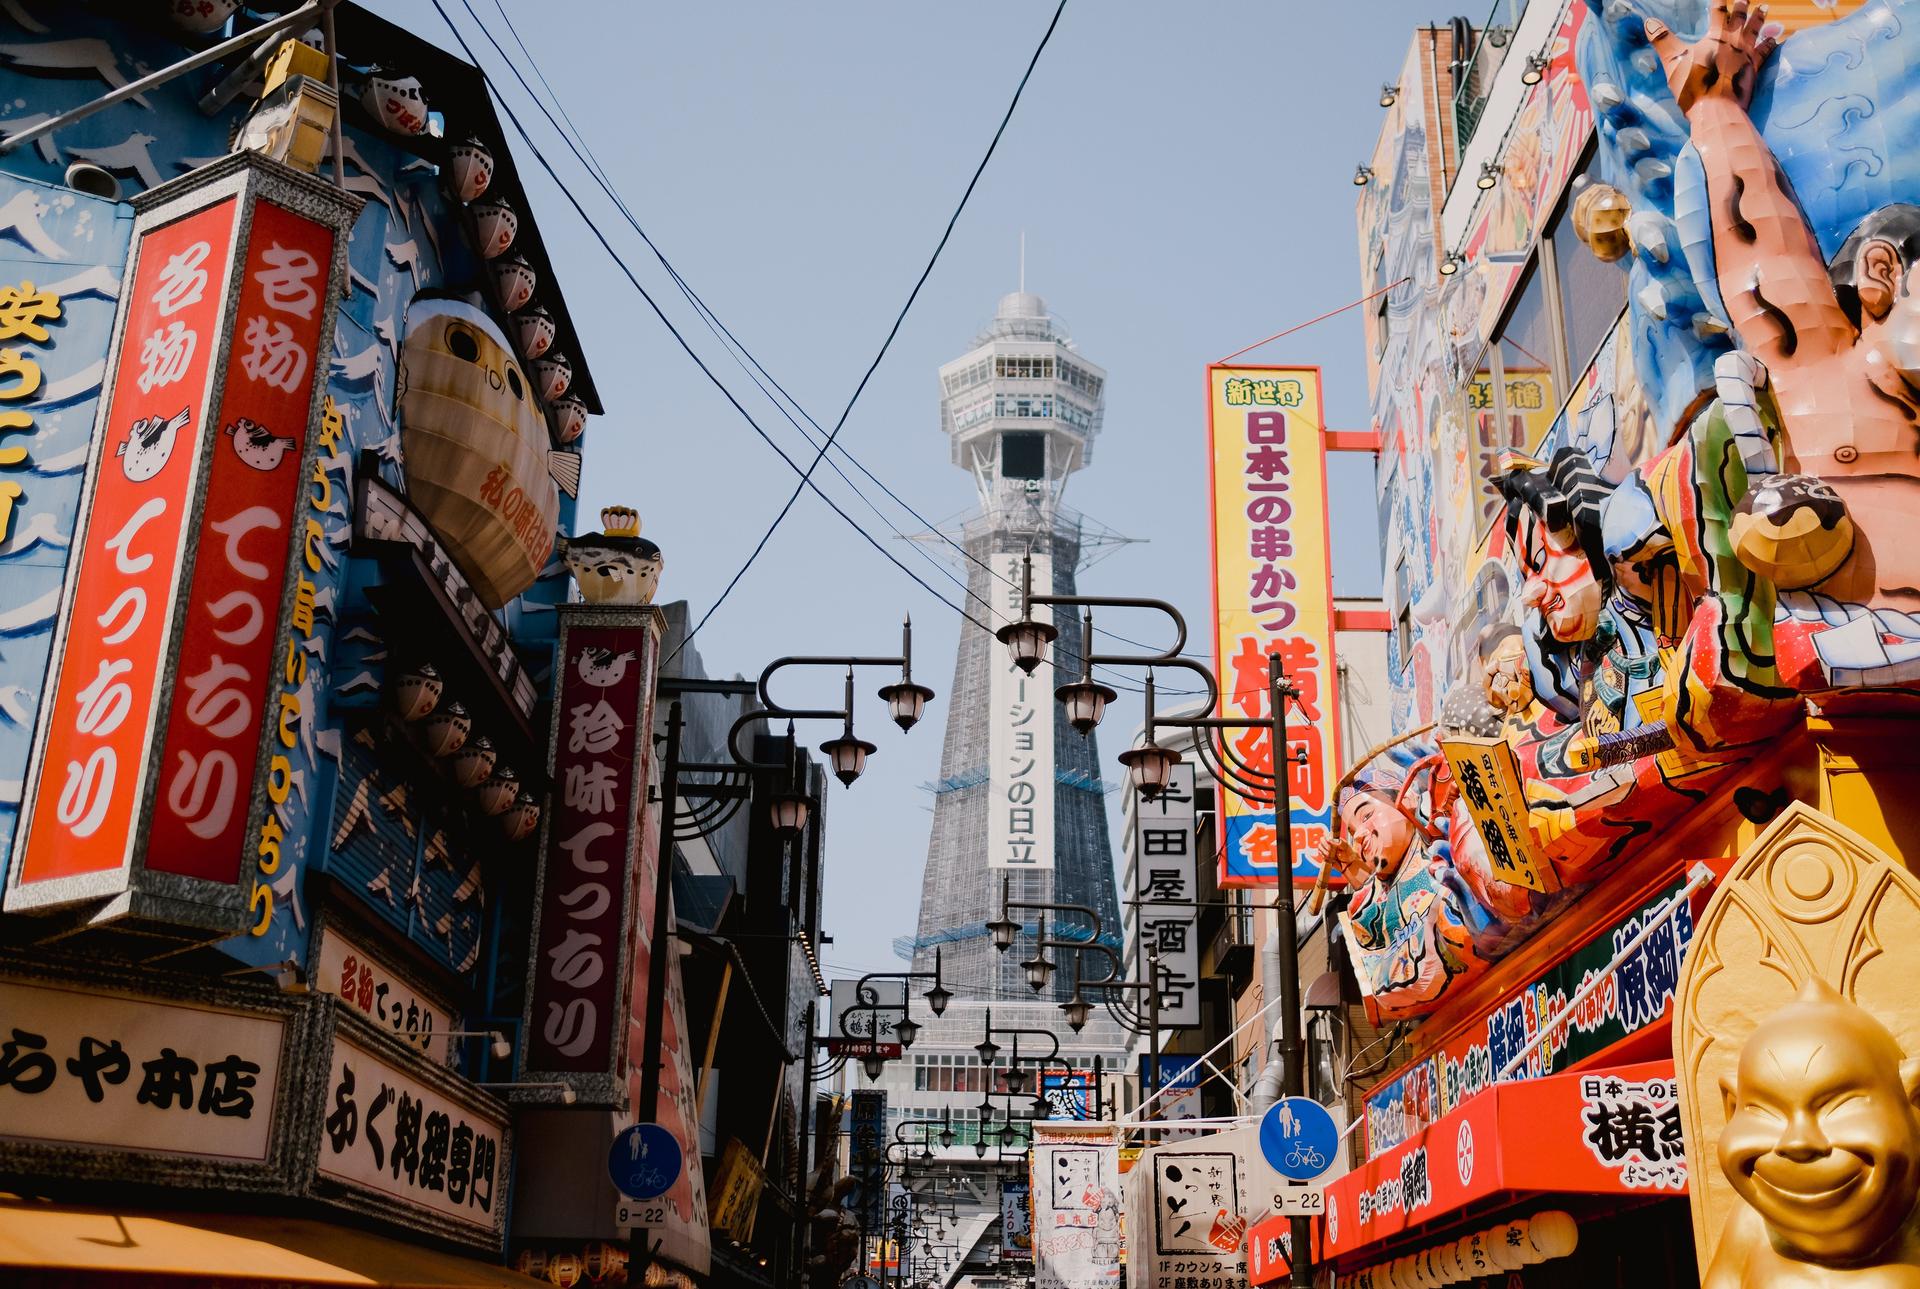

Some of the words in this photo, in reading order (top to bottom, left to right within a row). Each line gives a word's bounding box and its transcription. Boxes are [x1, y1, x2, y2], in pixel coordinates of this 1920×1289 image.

[137, 241, 212, 395] 名物
[242, 242, 320, 394] 名物
[1225, 379, 1303, 406] 新世界
[1245, 411, 1297, 632] 日本一の串かつ
[55, 497, 167, 840] てっちり
[168, 505, 284, 840] てっちり
[1231, 636, 1326, 812] 横綱
[545, 703, 624, 1057] 珍味てっちり
[0, 1028, 260, 1119] らや本店
[325, 1063, 496, 1213] ふぐ料理専門
[1401, 1148, 1430, 1213] 横綱
[1625, 1165, 1684, 1184] よこづな
[619, 1208, 664, 1222] 9-22
[1274, 1193, 1321, 1209] 9-22
[1159, 1262, 1171, 1272] 1F
[1174, 1261, 1247, 1274] カウンター席
[1159, 1278, 1171, 1289] 2F
[1174, 1277, 1247, 1289] 座敷あります
